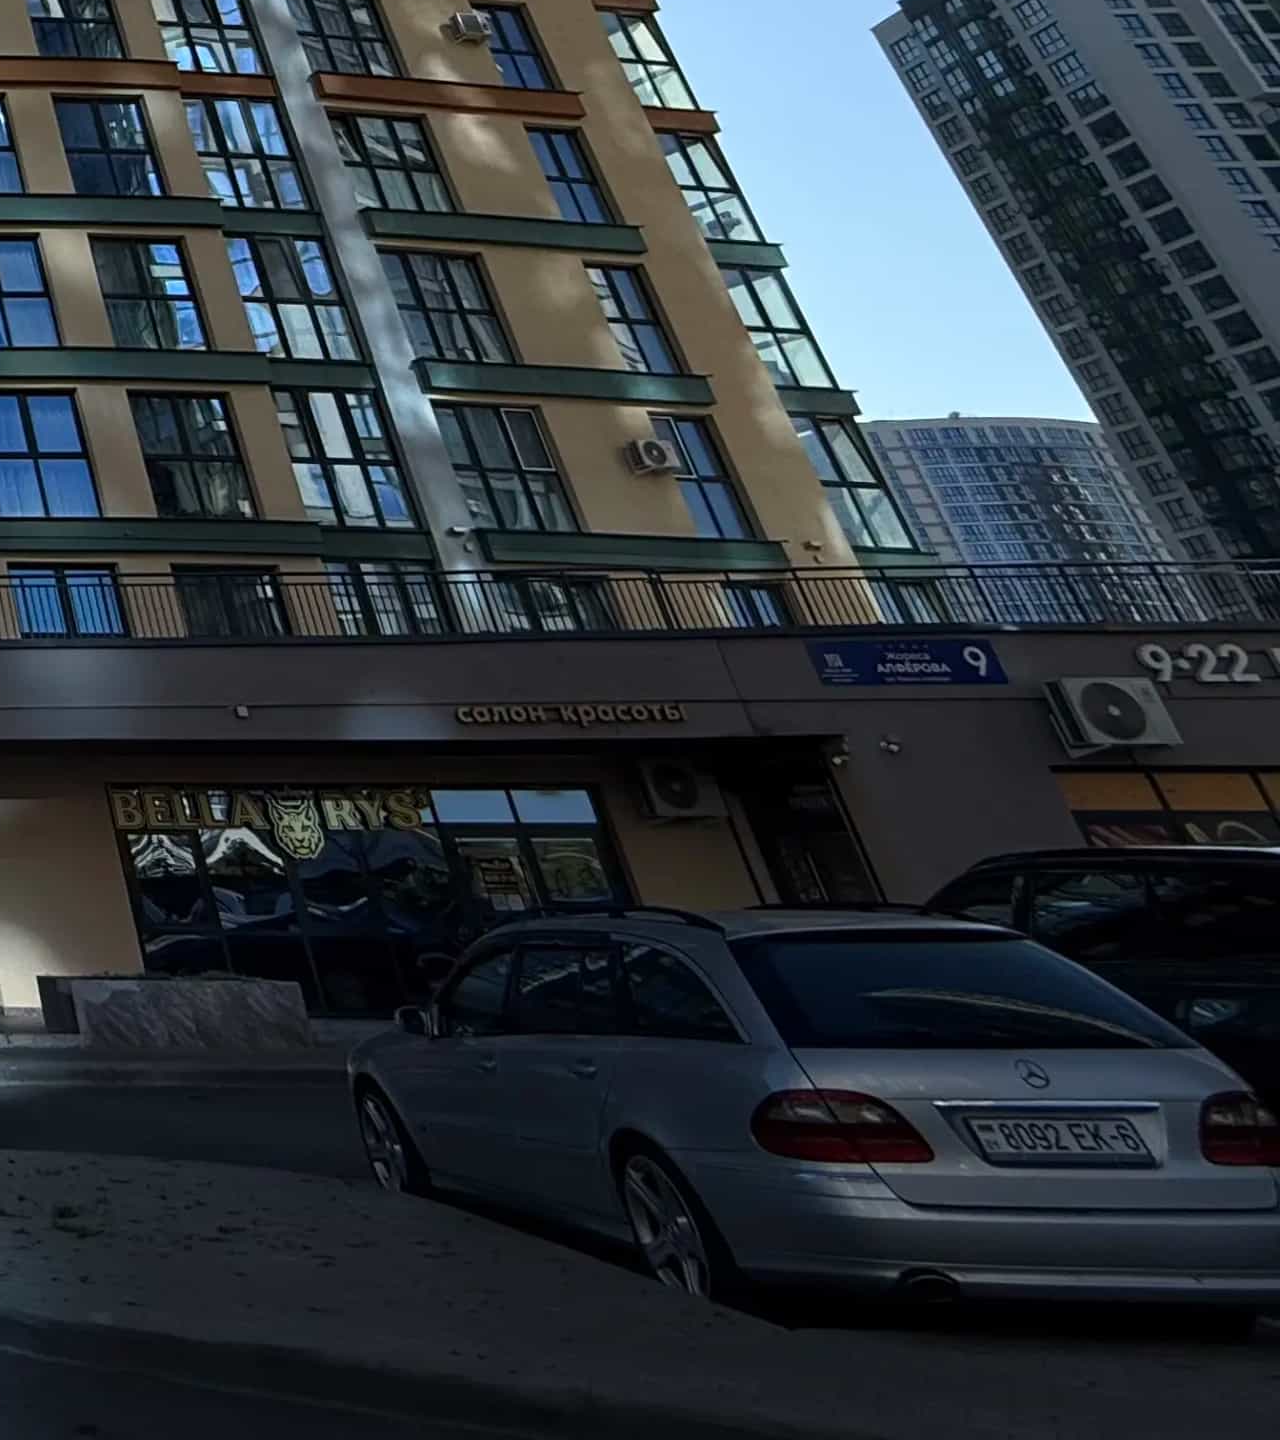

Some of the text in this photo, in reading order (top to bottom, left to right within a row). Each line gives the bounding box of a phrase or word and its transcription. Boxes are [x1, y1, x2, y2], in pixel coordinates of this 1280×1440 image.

[962, 645, 988, 677] 9
[456, 702, 689, 729] салон красоты
[111, 791, 272, 831] BELLA
[999, 1123, 1140, 1152] 8092 EK-6
